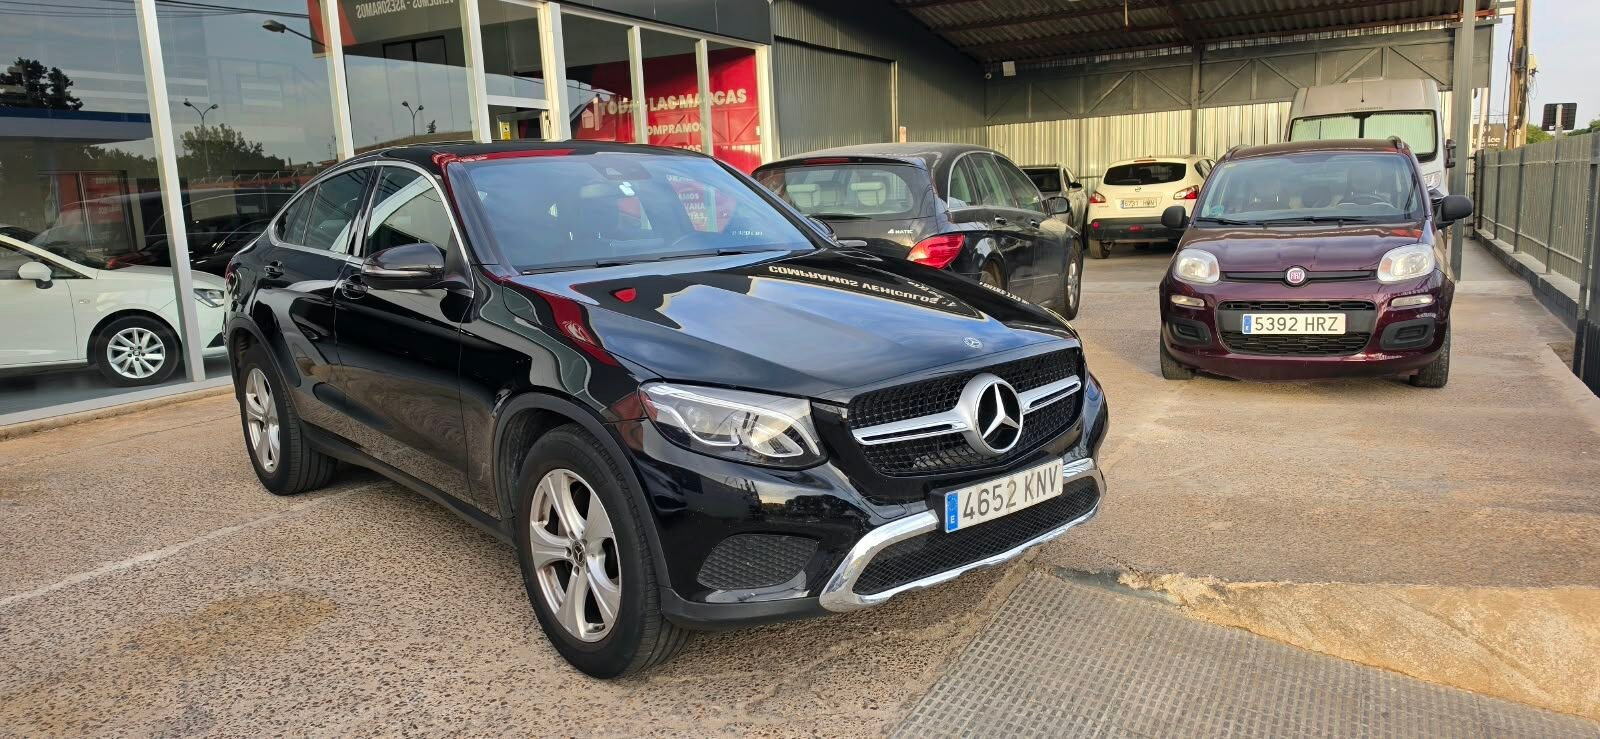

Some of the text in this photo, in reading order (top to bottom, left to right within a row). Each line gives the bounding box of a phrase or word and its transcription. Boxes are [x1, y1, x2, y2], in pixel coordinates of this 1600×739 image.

[650, 97, 677, 112] LAS
[648, 122, 702, 136] OMPRAMO
[1290, 272, 1302, 280] FIAT
[1255, 316, 1298, 332] 5392
[1304, 316, 1338, 332] HRZ
[962, 479, 1017, 520] 4652
[1024, 464, 1058, 502] KNV
